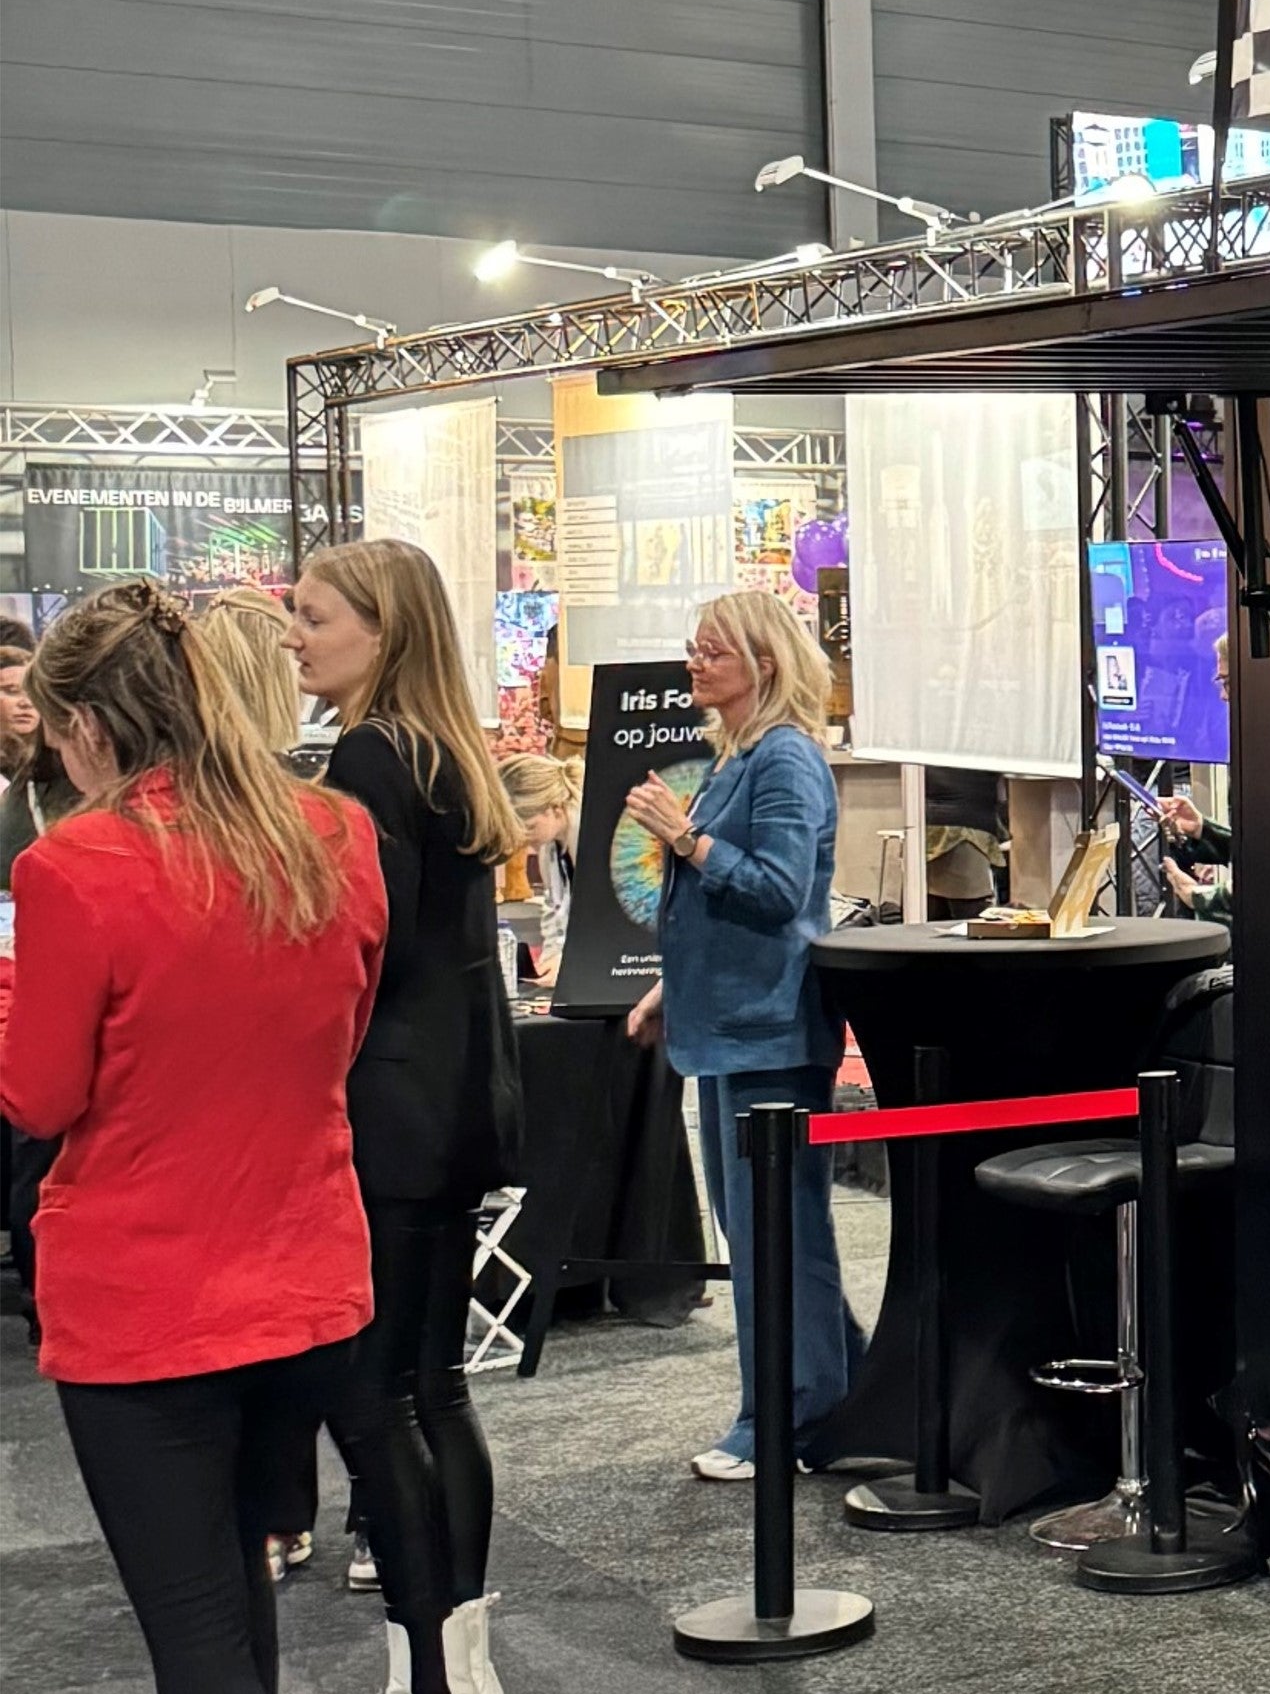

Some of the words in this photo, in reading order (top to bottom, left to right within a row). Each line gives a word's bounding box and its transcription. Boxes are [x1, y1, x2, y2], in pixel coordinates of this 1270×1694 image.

[27, 487, 169, 507] EVENEMENTEN
[173, 490, 192, 507] IN
[196, 490, 221, 508] DE
[621, 689, 658, 712] Iris
[613, 728, 644, 749] op
